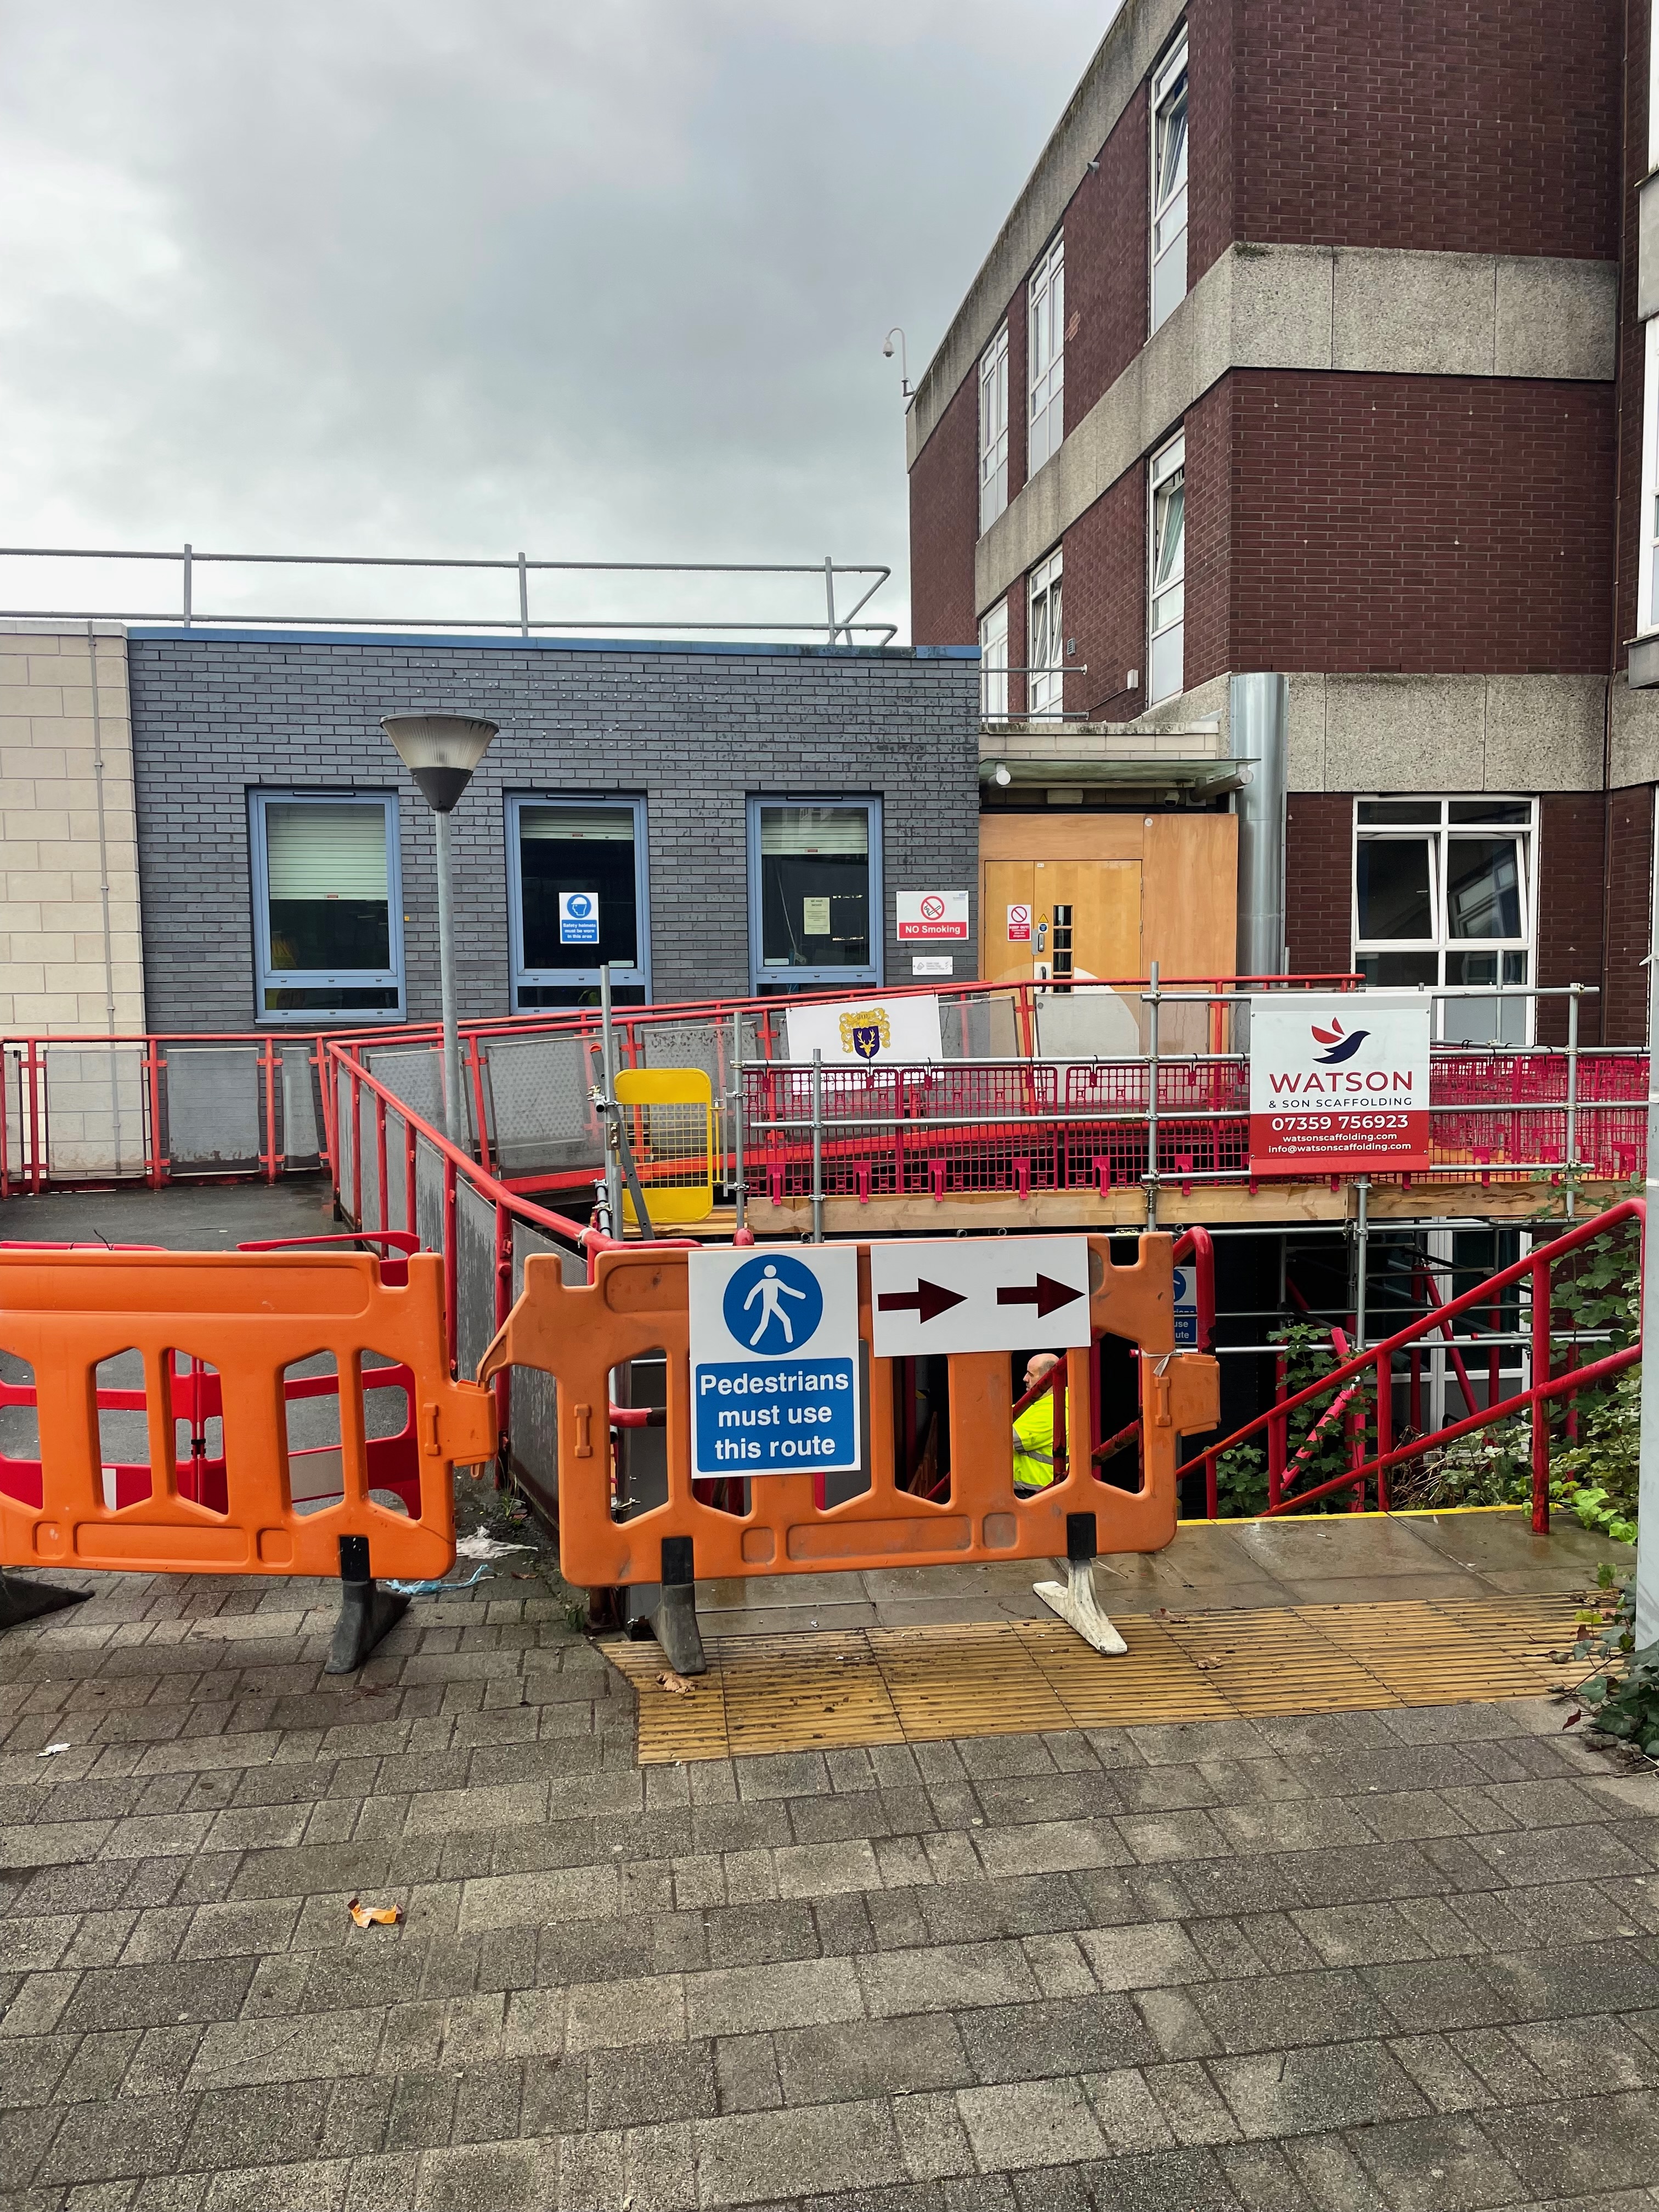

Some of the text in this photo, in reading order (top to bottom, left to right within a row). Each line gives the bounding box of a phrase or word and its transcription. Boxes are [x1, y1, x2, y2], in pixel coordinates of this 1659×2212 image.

[922, 925, 960, 935] Smoking
[1269, 1071, 1412, 1093] WATSON
[1269, 1097, 1412, 1108] & SON SCAFFOLDING
[1272, 1114, 1408, 1131] 07359 756923
[1283, 1133, 1397, 1142] watsonscaffolding.com
[1268, 1143, 1412, 1154] info@watsonscaffolding.com
[700, 1370, 849, 1396] Pedestrians
[718, 1405, 832, 1427] must use
[714, 1435, 836, 1460] this route
